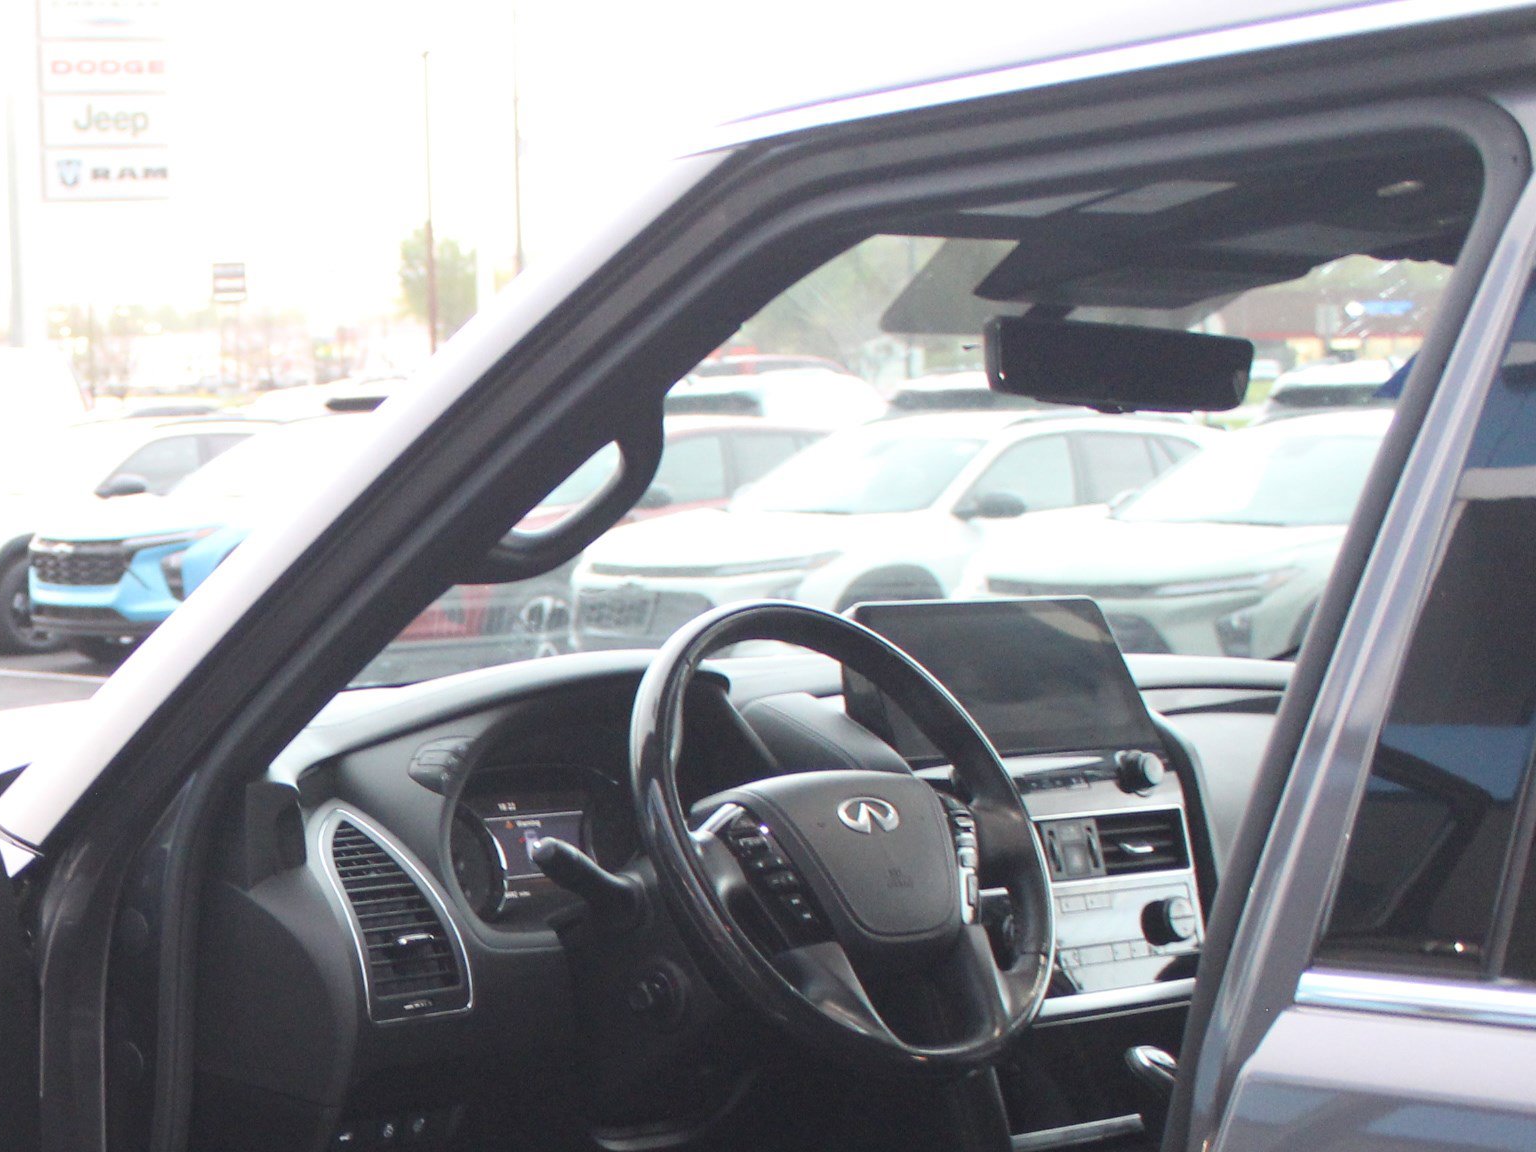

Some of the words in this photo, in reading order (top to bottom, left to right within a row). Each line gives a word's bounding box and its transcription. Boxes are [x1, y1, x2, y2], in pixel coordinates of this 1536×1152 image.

[51, 60, 165, 75] DODGE
[73, 104, 149, 137] Jeep
[91, 167, 169, 181] RAM
